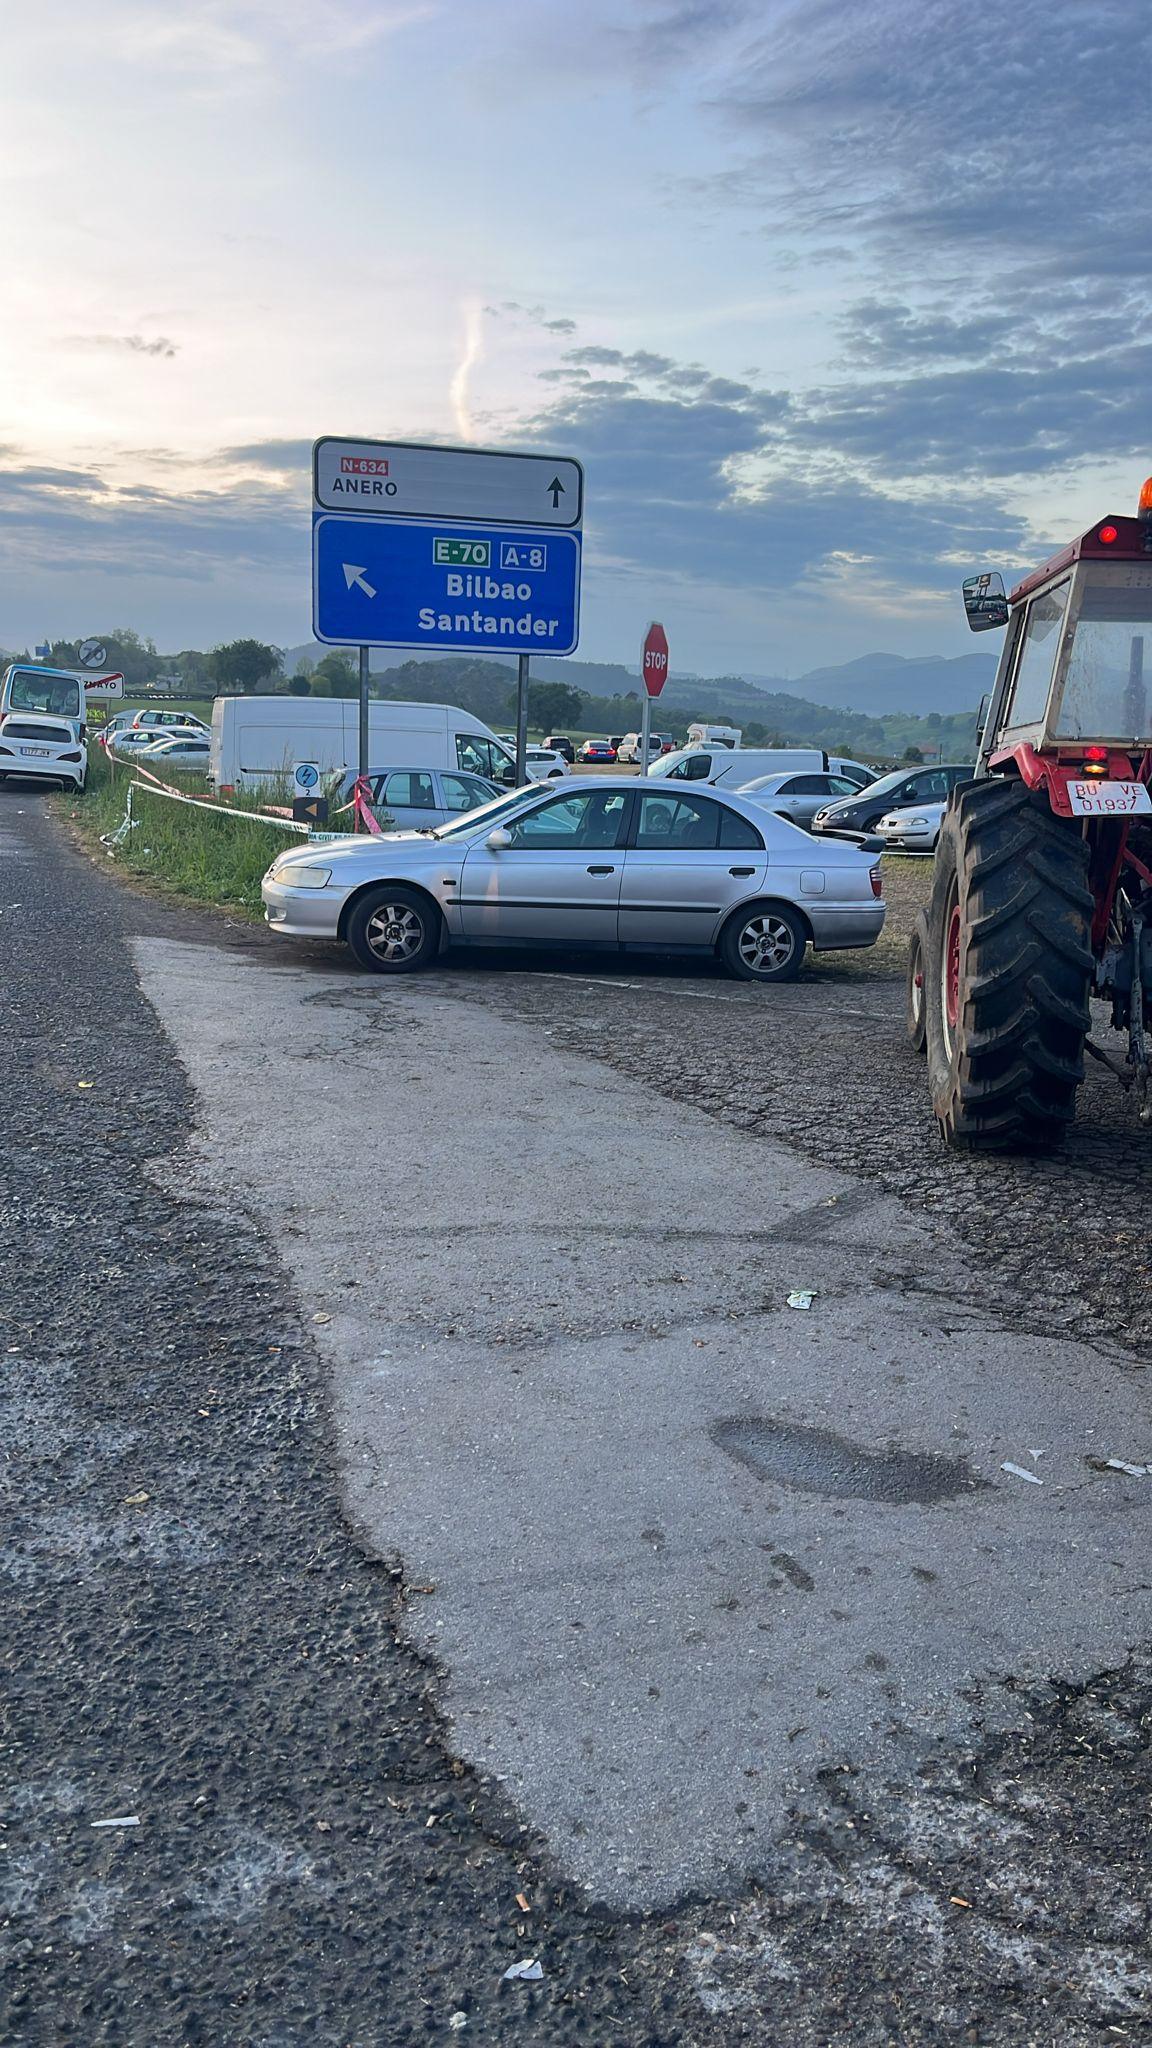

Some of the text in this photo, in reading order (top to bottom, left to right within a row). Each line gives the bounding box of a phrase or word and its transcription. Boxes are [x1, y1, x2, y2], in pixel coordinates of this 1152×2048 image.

[342, 459, 387, 475] N-634
[332, 478, 398, 496] ANERO
[436, 542, 543, 568] E-70 A-8
[447, 573, 532, 601] Bilbao
[417, 608, 559, 637] Santander
[645, 652, 667, 670] STOP
[1075, 785, 1143, 796] BU VE
[1082, 799, 1136, 811] 01937
